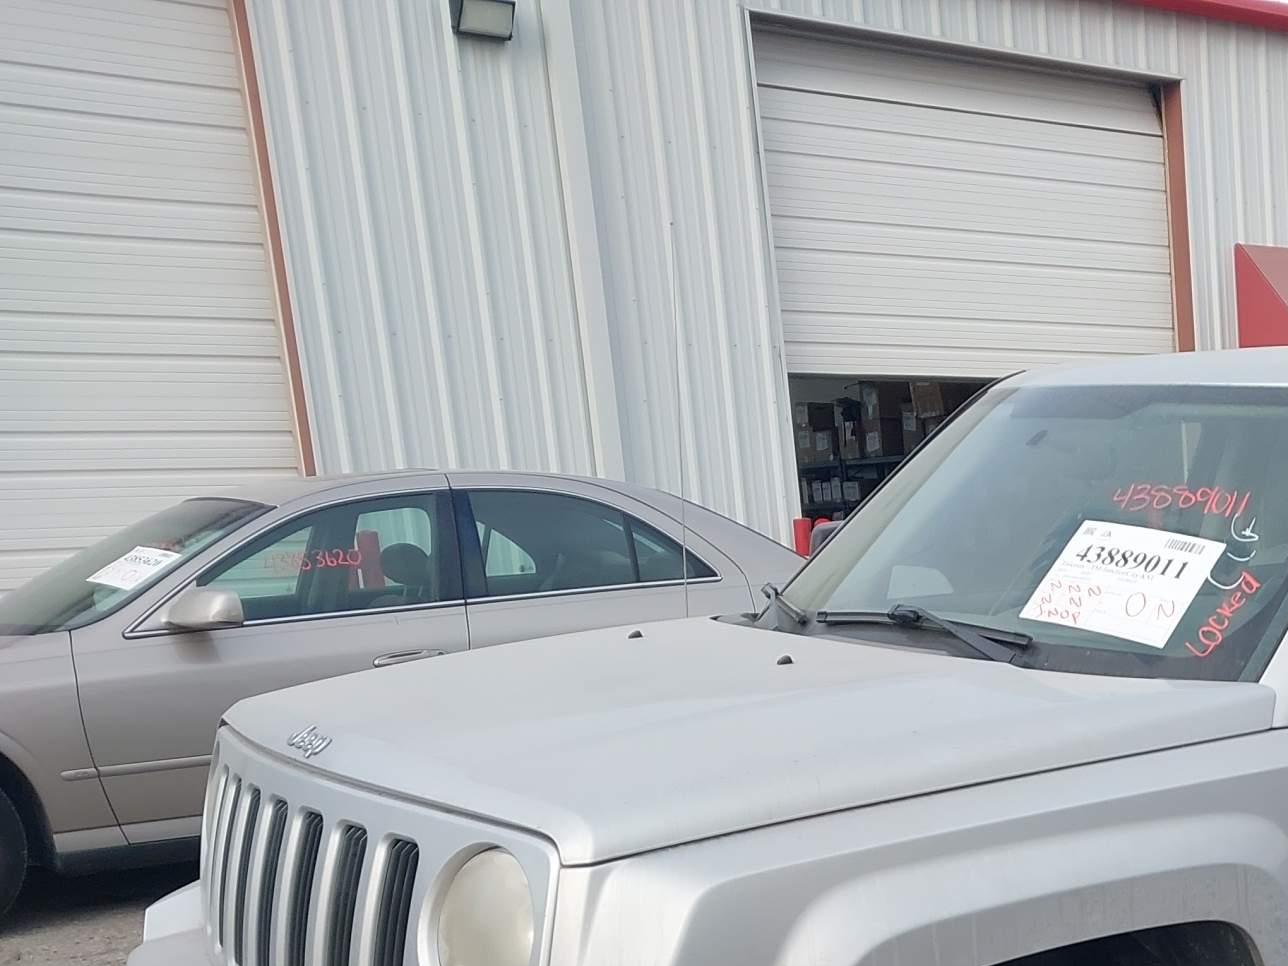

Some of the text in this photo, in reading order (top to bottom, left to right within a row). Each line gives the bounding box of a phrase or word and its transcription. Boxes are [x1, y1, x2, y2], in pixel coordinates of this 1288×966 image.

[1113, 483, 1251, 518] 43889011
[1076, 544, 1188, 580] 43889011
[287, 723, 333, 759] Jeep
